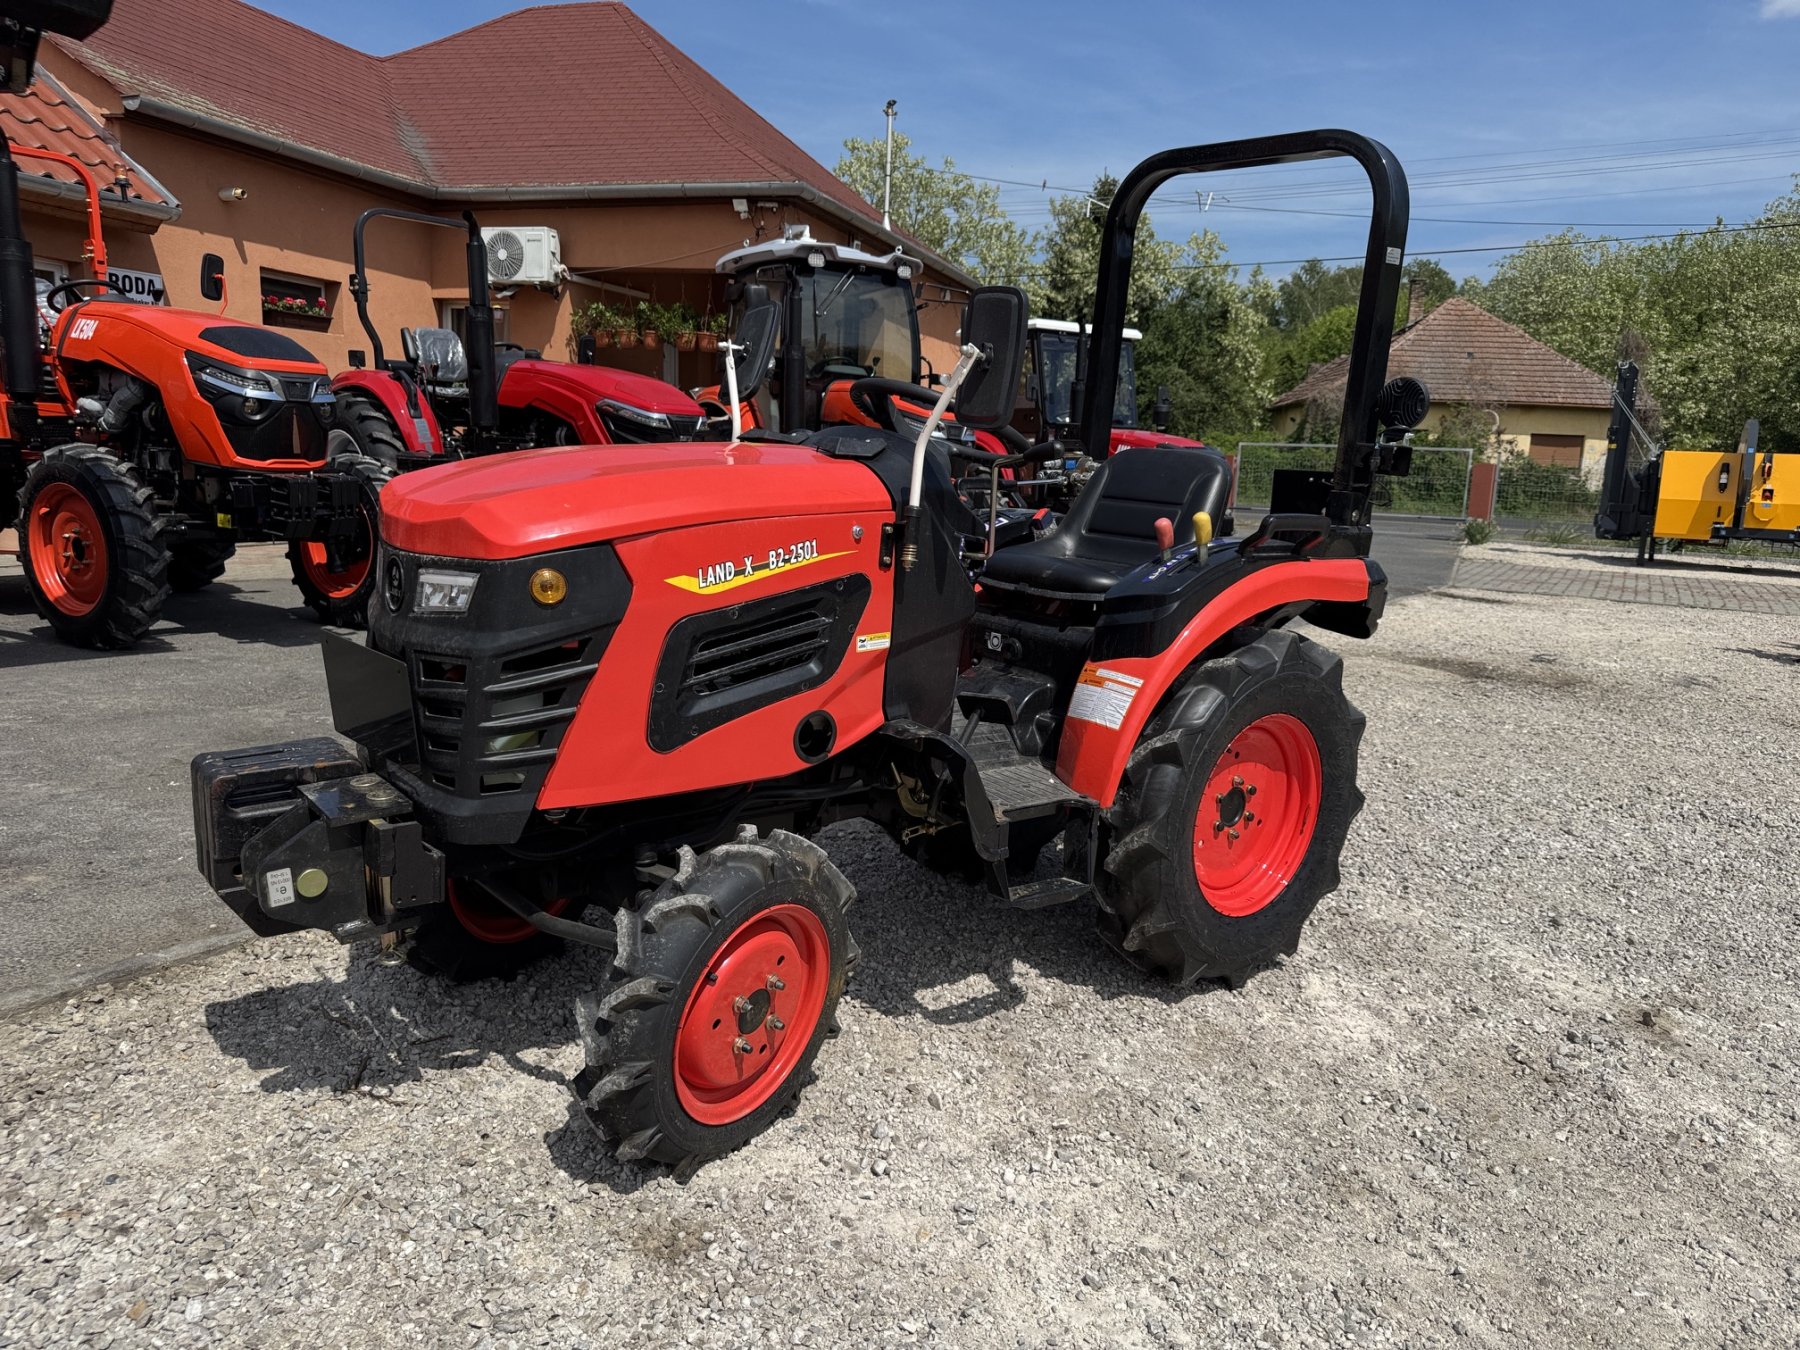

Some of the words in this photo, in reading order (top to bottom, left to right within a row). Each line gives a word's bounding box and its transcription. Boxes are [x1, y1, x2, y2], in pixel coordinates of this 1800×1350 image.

[108, 272, 156, 296] BODA
[70, 318, 99, 340] LX504
[697, 561, 735, 589] LAND
[743, 555, 754, 578] X
[768, 538, 819, 570] B2-2501
